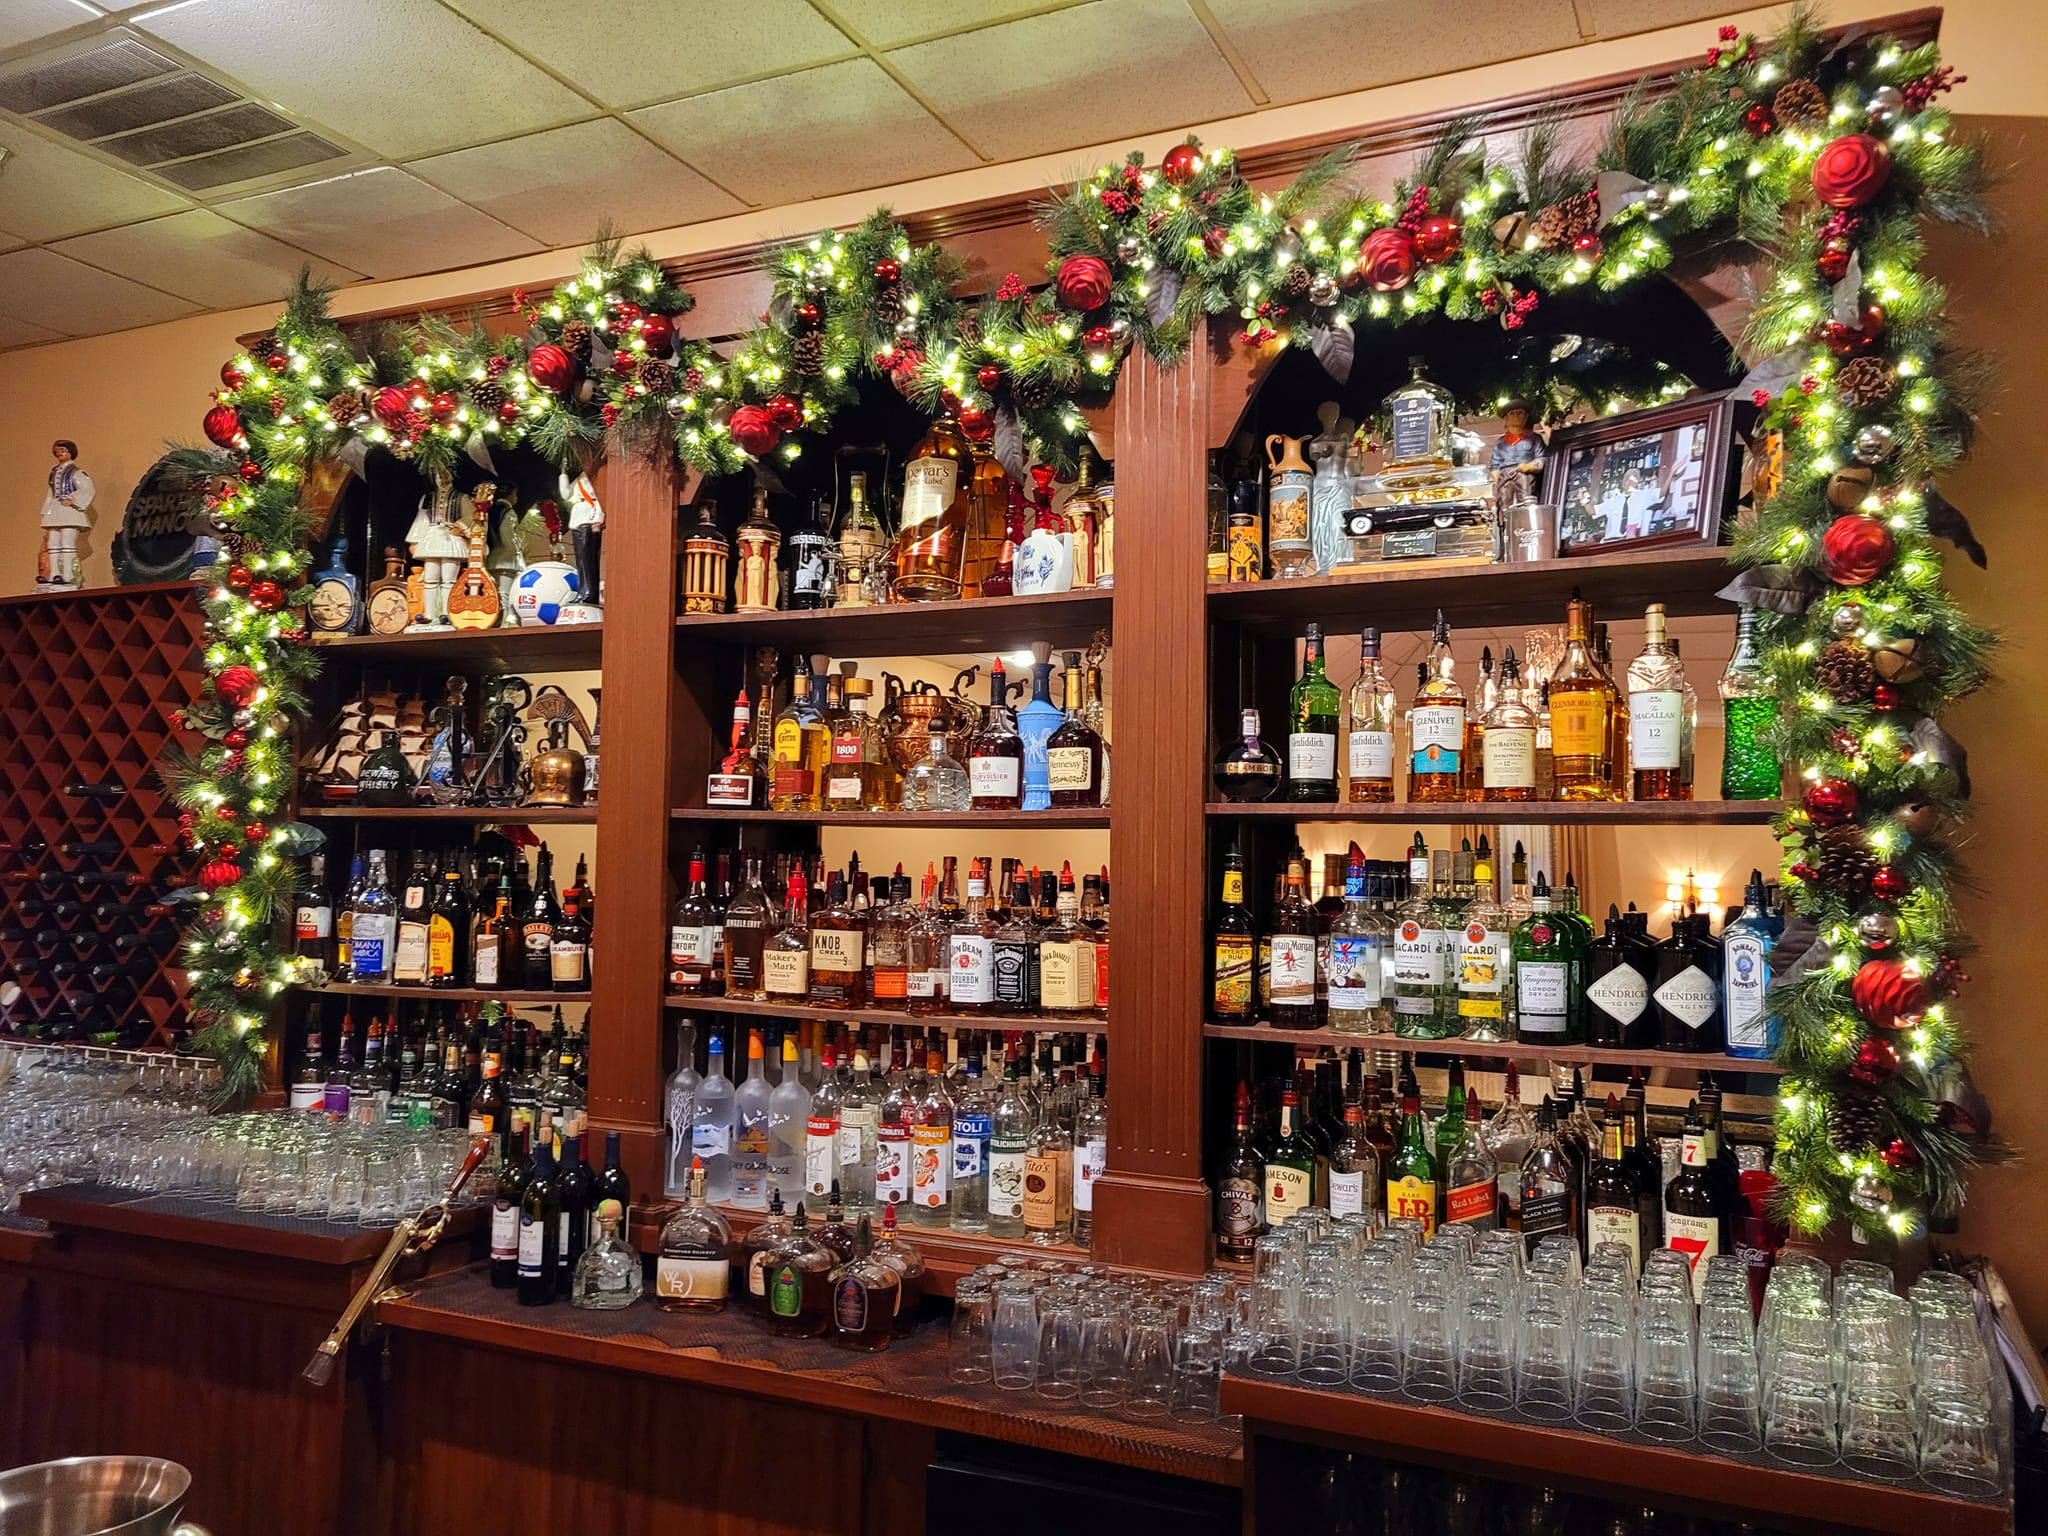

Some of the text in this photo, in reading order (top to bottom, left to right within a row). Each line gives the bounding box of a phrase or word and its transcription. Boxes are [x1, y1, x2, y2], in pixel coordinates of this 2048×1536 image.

[1416, 716, 1455, 726] GLENLIVET
[1429, 725, 1439, 734] 12
[1648, 728, 1661, 737] 12
[836, 745, 857, 755] 1800
[1049, 760, 1081, 770] Hennessy
[814, 935, 841, 950] KNOB
[962, 941, 983, 959] BEAM
[766, 953, 797, 962] Maker's
[843, 956, 848, 966] 9
[1336, 965, 1352, 975] BAY
[954, 1119, 983, 1133] STOLI
[1685, 1144, 1696, 1163] 7
[1026, 1159, 1050, 1173] Tito's
[1221, 1190, 1254, 1201] CHIVAS
[1451, 1192, 1490, 1210] Red Label
[1522, 1206, 1562, 1219] BLACK LABEL
[1669, 1215, 1709, 1229] Seagram's
[1595, 1223, 1633, 1234] Seagram's
[1670, 1236, 1710, 1273] 7
